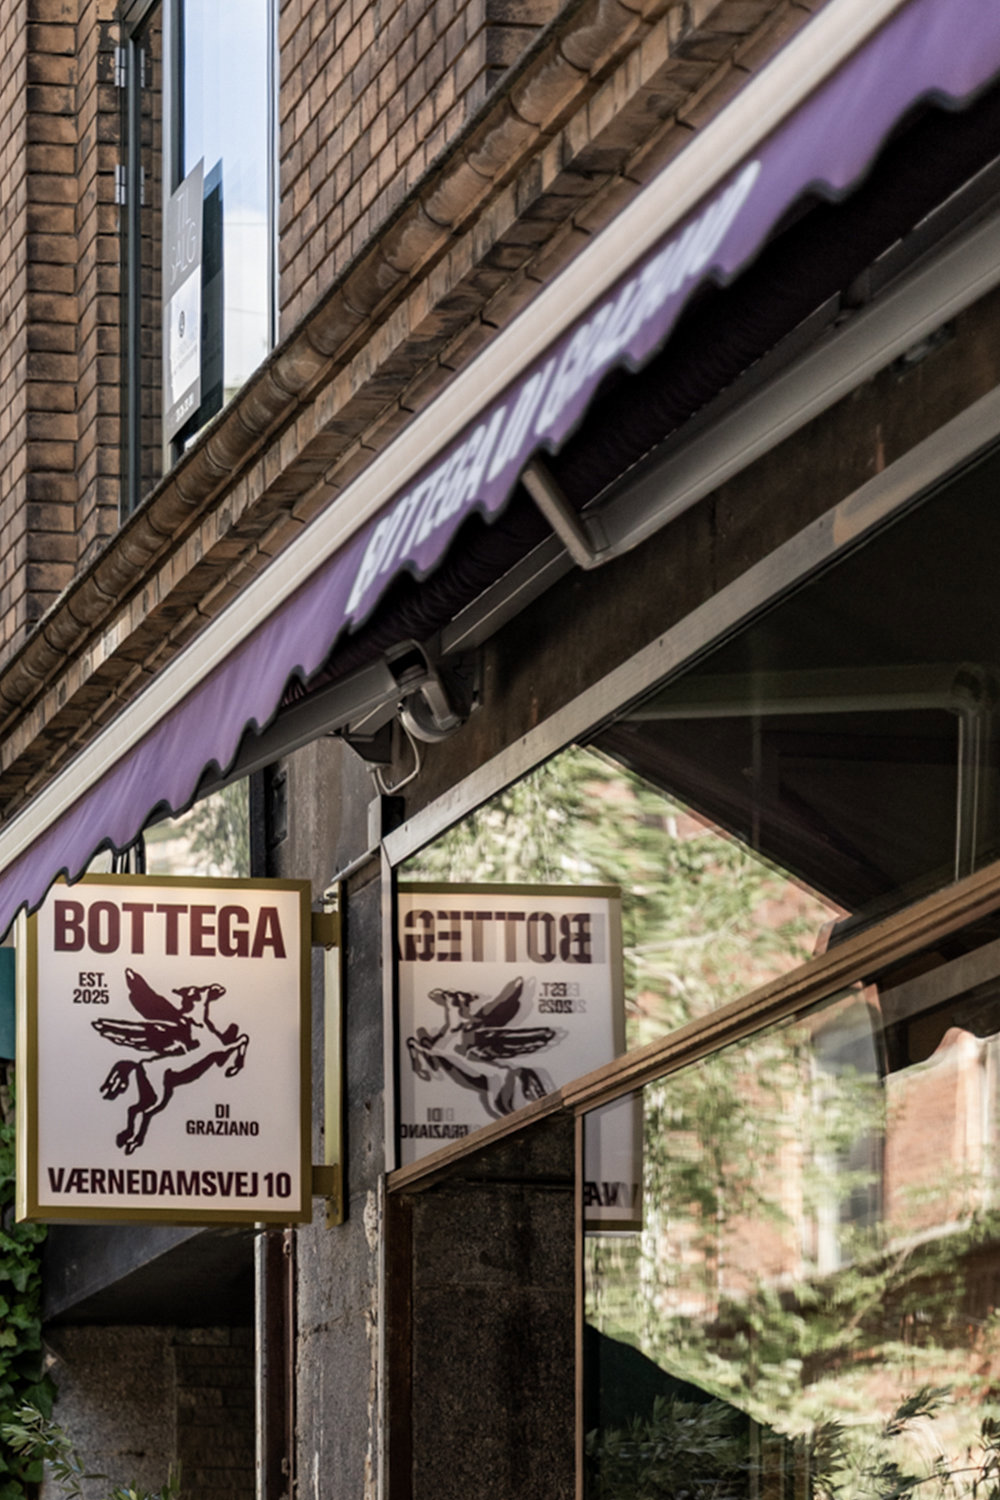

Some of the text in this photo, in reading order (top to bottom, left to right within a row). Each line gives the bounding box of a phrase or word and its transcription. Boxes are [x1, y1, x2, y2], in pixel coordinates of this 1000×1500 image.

[486, 356, 557, 483] DI
[53, 899, 287, 959] BOTTEGA
[78, 971, 108, 988] EST.
[73, 988, 110, 1004] 2025
[215, 1104, 230, 1119] DI
[186, 1120, 259, 1136] GRAZIANO
[48, 1167, 292, 1198] VÆRNEDAMSVEJ 10
